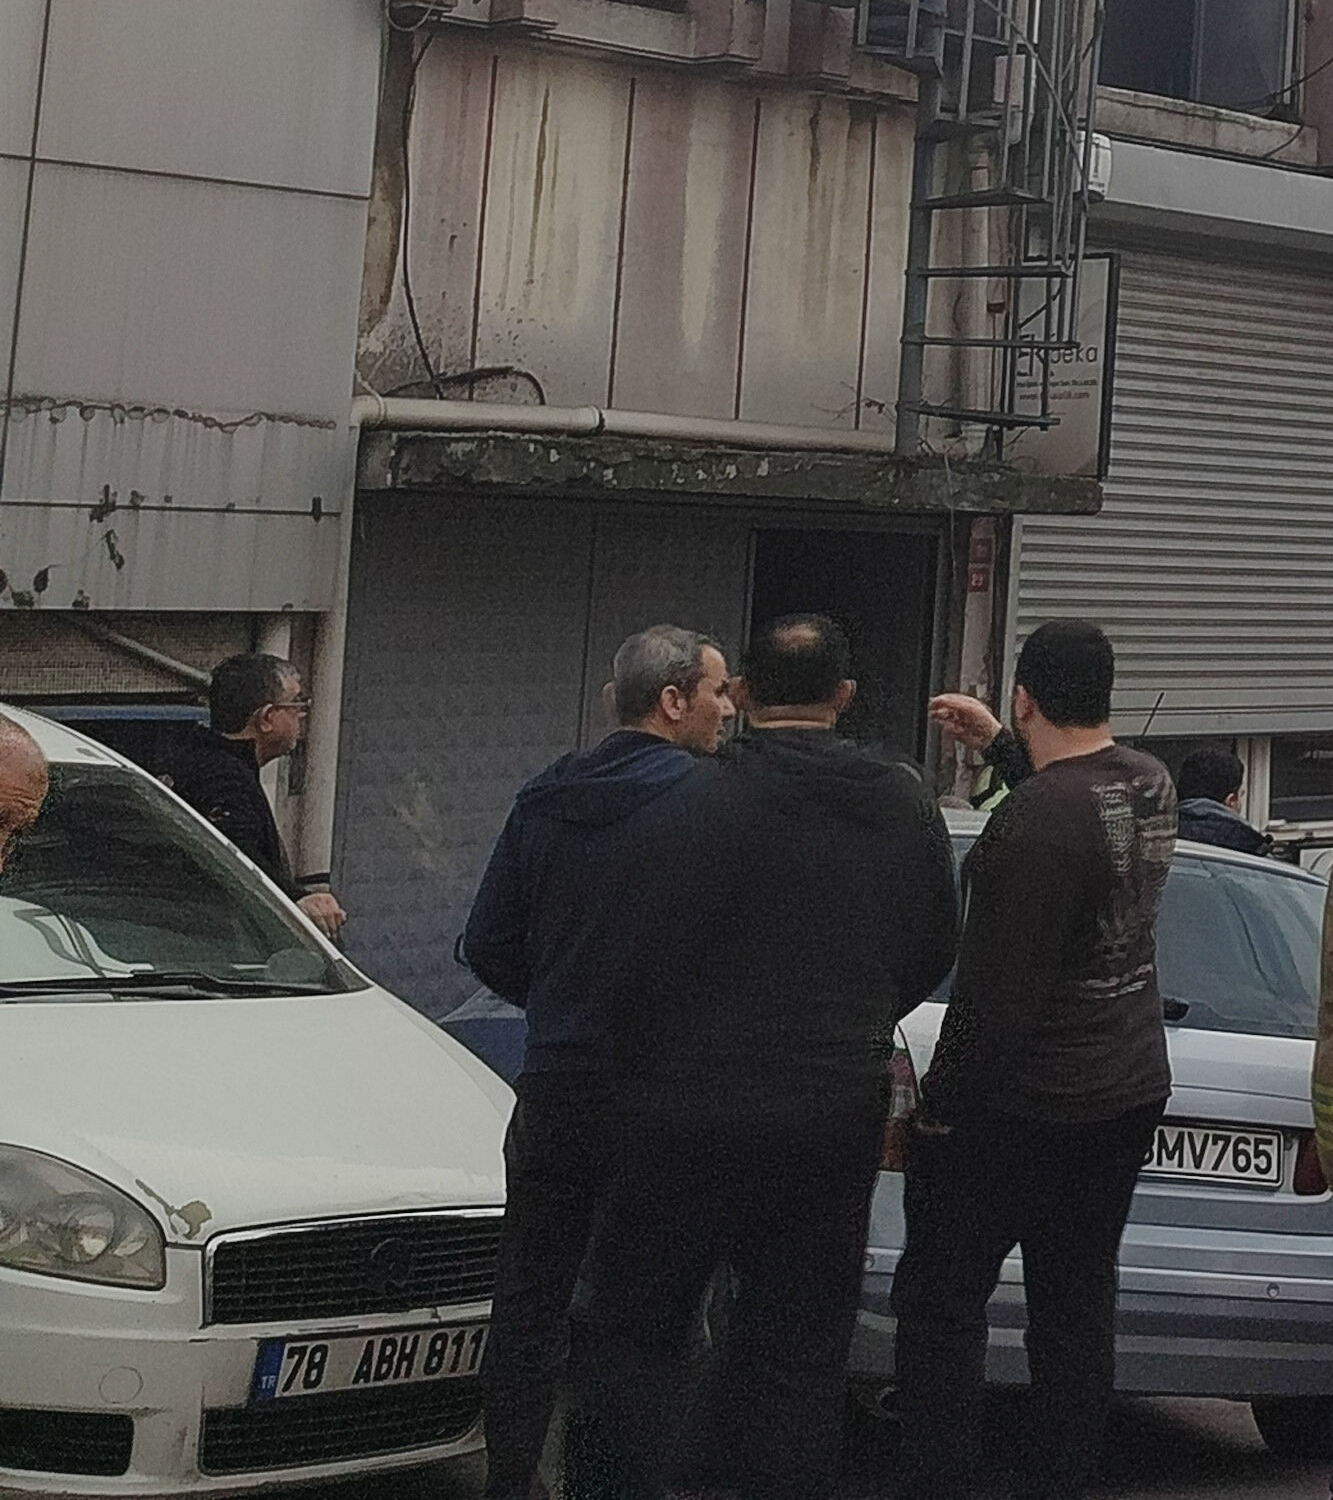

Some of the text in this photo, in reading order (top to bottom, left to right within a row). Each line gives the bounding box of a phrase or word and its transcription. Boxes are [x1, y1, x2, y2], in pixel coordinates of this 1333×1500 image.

[282, 1327, 484, 1392] 78 ABH 811
[261, 1375, 276, 1389] TR
